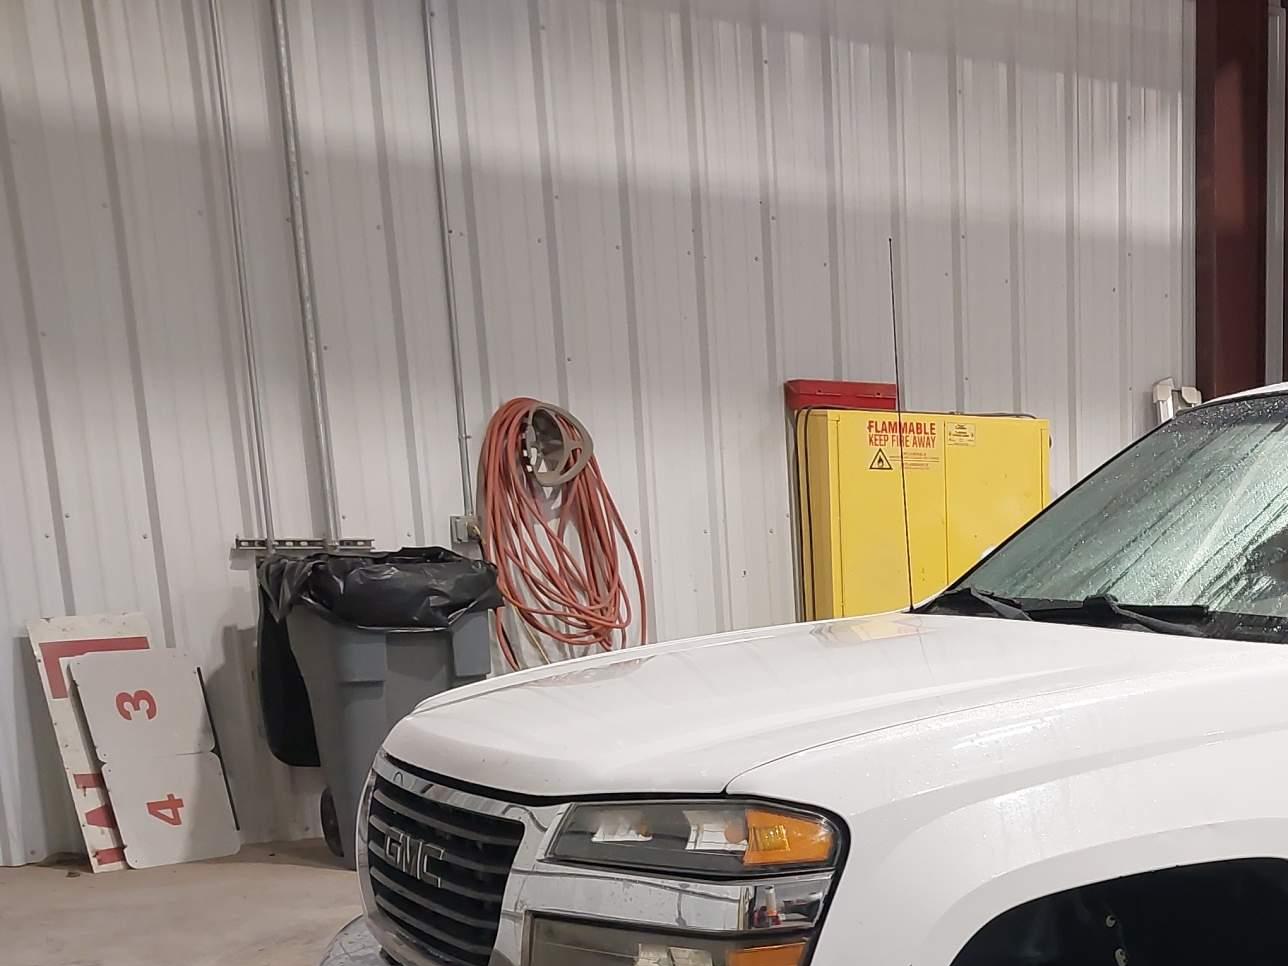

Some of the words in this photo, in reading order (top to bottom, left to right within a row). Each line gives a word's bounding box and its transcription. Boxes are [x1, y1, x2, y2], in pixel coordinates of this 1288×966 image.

[867, 420, 937, 435] FLAMMABLE
[868, 434, 889, 447] KEEP
[891, 435, 911, 448] FIRE
[912, 435, 937, 449] AWAY
[115, 689, 158, 721] 3
[146, 793, 185, 827] 4
[384, 826, 446, 889] GMC
